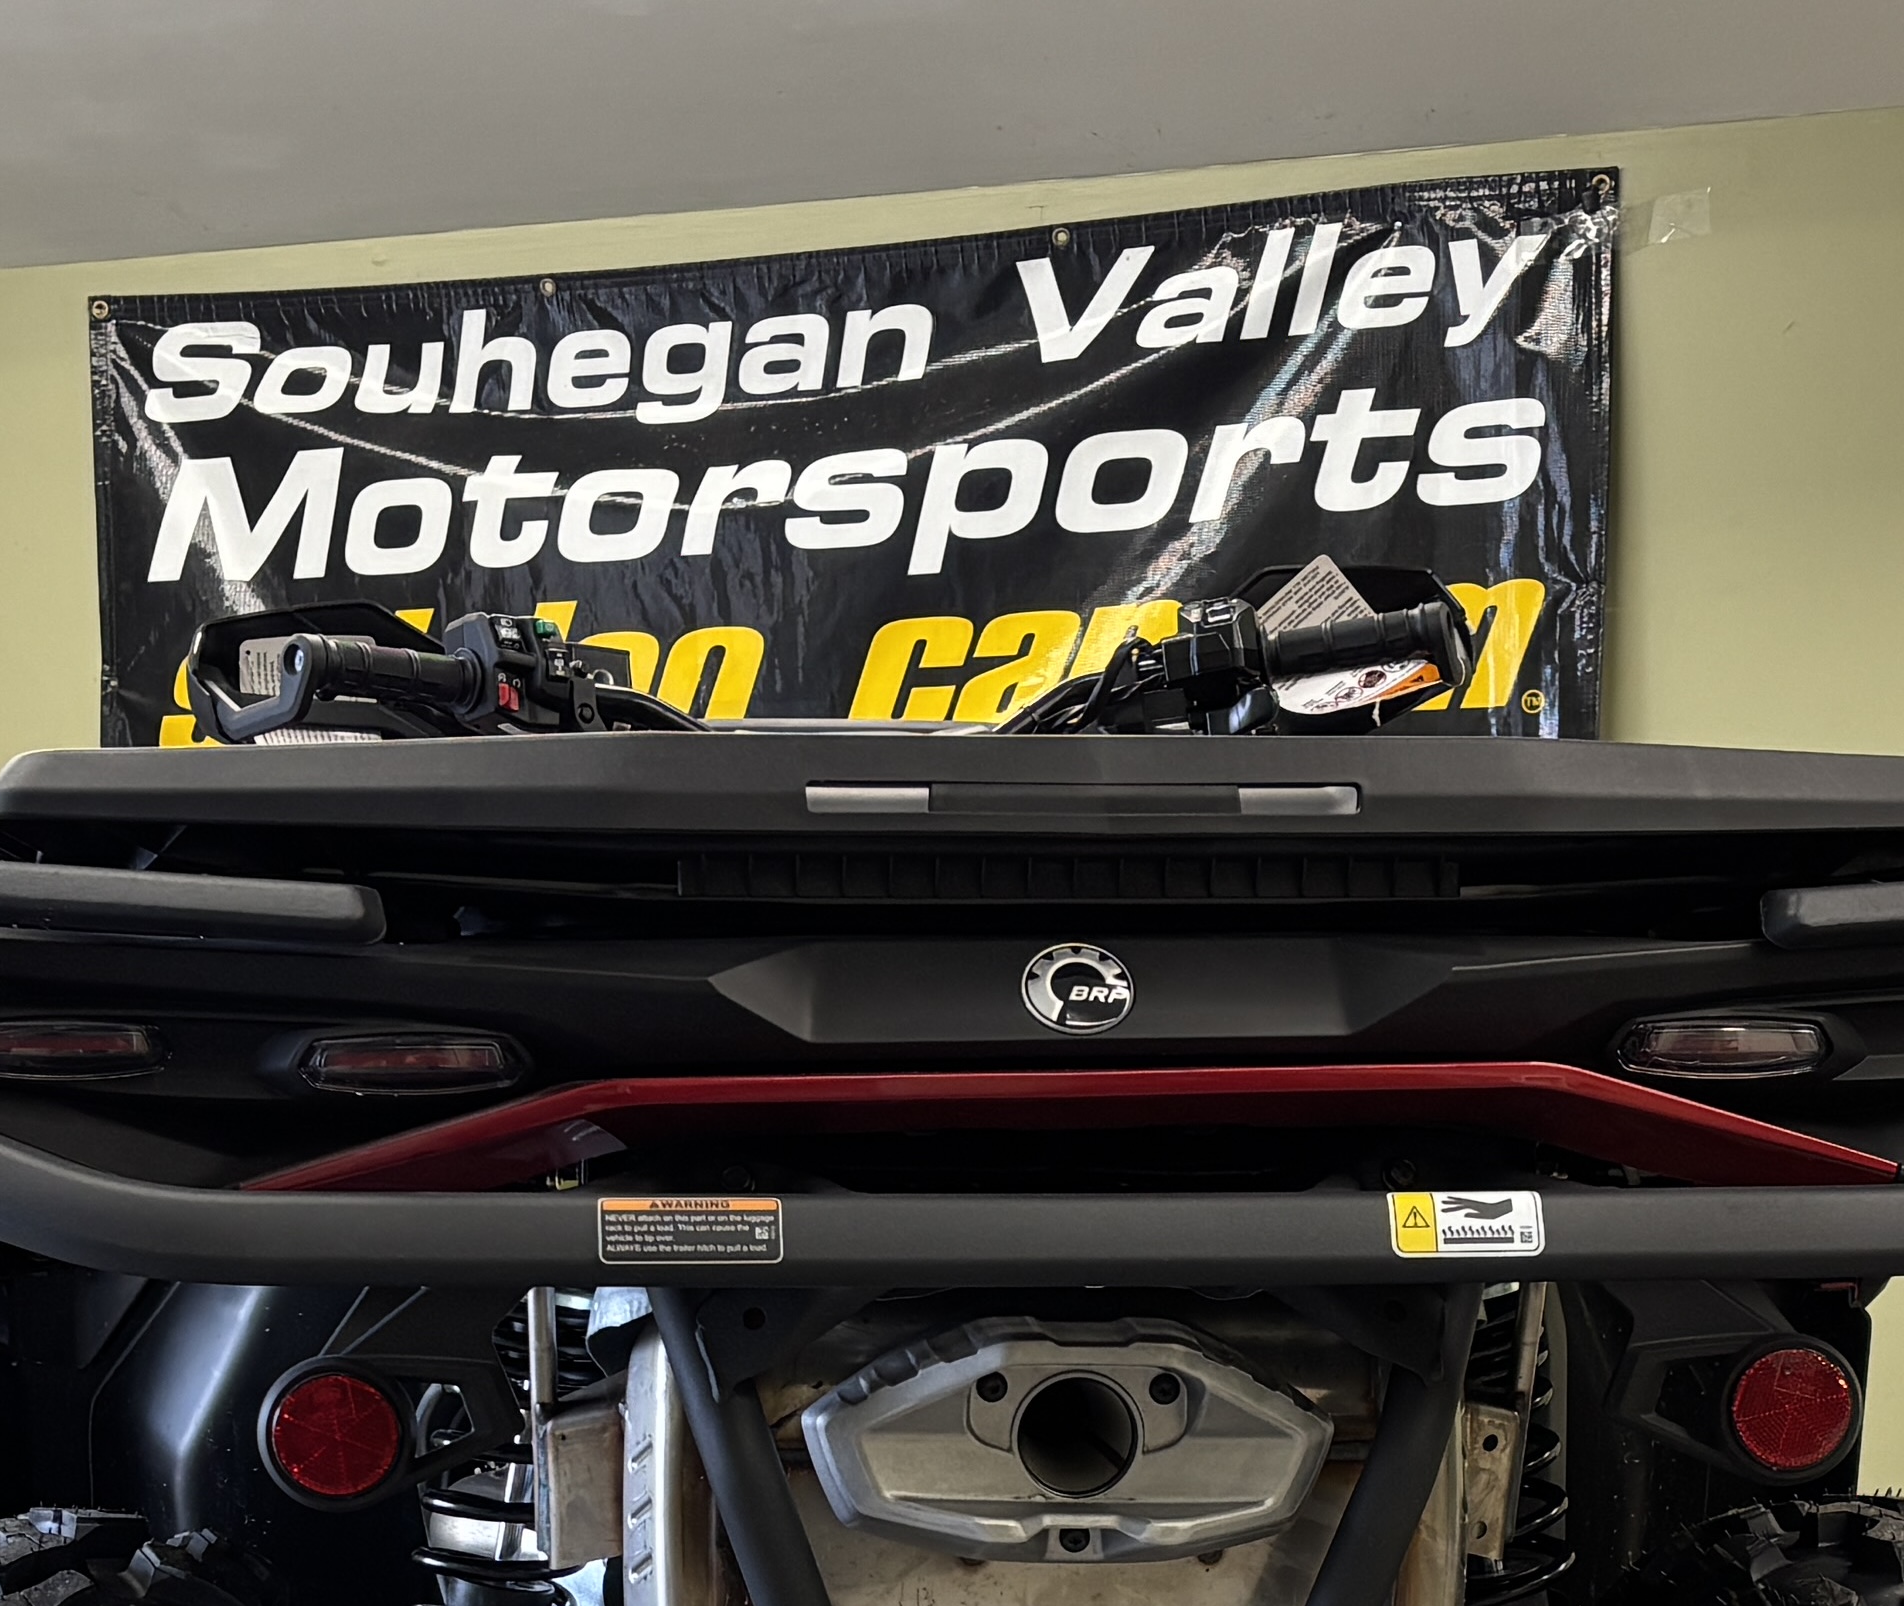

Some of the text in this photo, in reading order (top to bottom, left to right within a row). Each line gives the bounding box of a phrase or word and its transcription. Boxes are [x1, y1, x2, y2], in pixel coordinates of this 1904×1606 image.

[145, 222, 1551, 425] Souhegan Valley
[147, 387, 1545, 583] Motorsports
[1069, 985, 1130, 1003] BRP
[660, 1200, 730, 1209] WARNING
